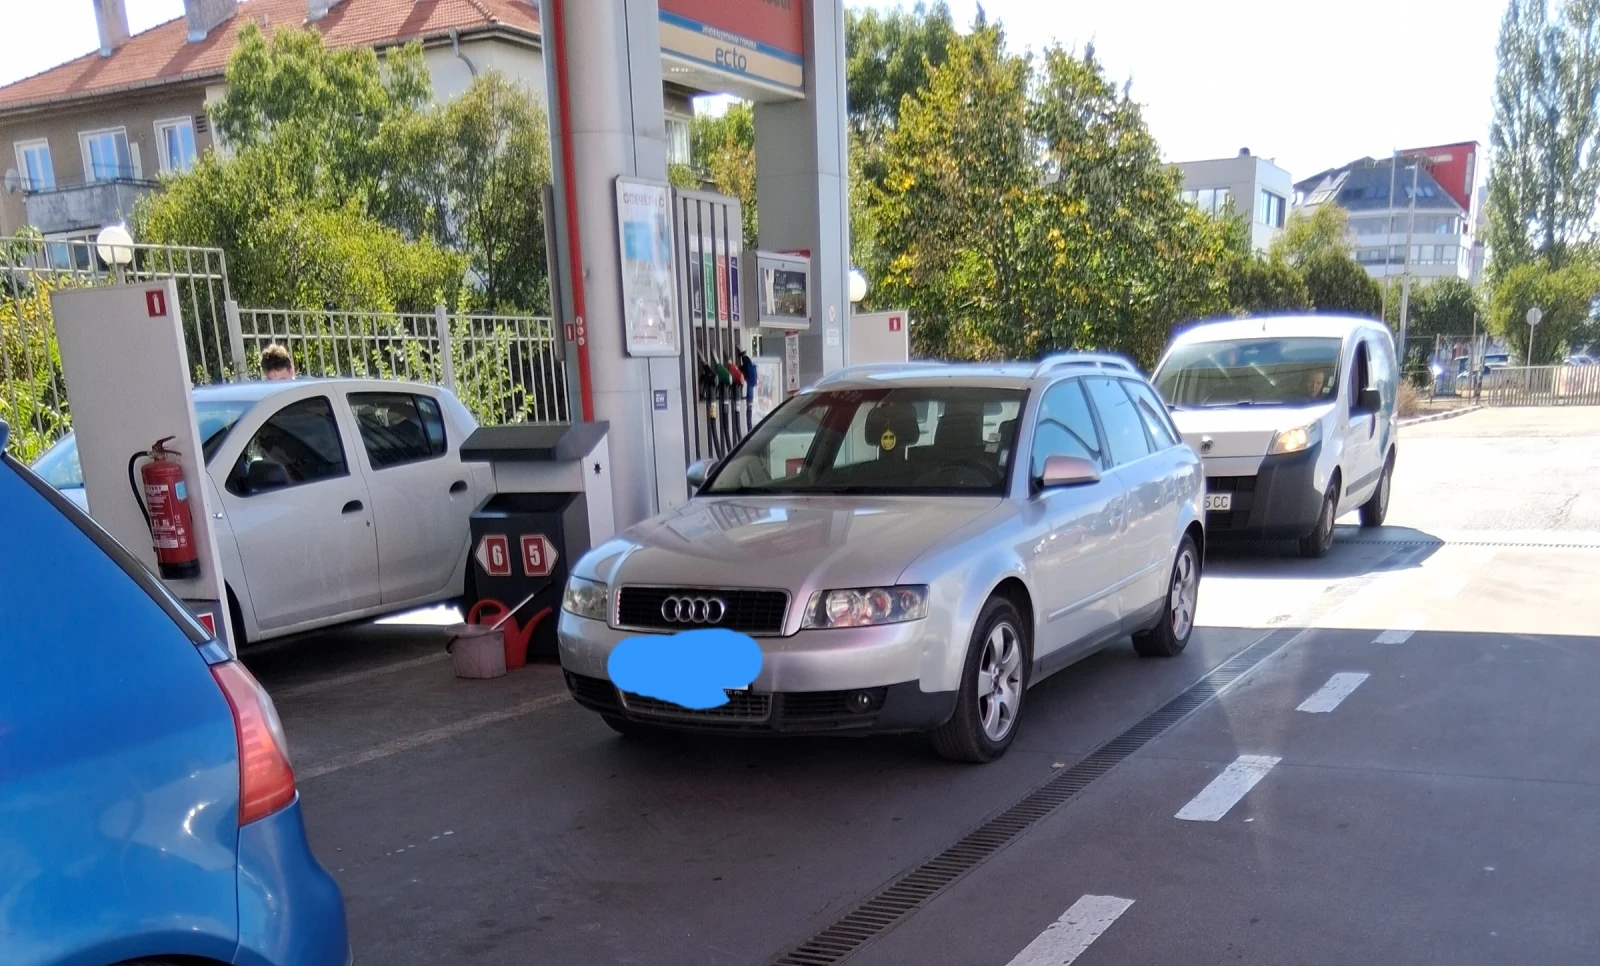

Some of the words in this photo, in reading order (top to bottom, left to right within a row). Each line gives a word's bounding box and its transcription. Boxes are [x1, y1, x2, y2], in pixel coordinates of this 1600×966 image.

[715, 47, 747, 72] ecto
[1213, 496, 1229, 508] CC
[492, 545, 503, 566] 6
[528, 545, 540, 566] 5
